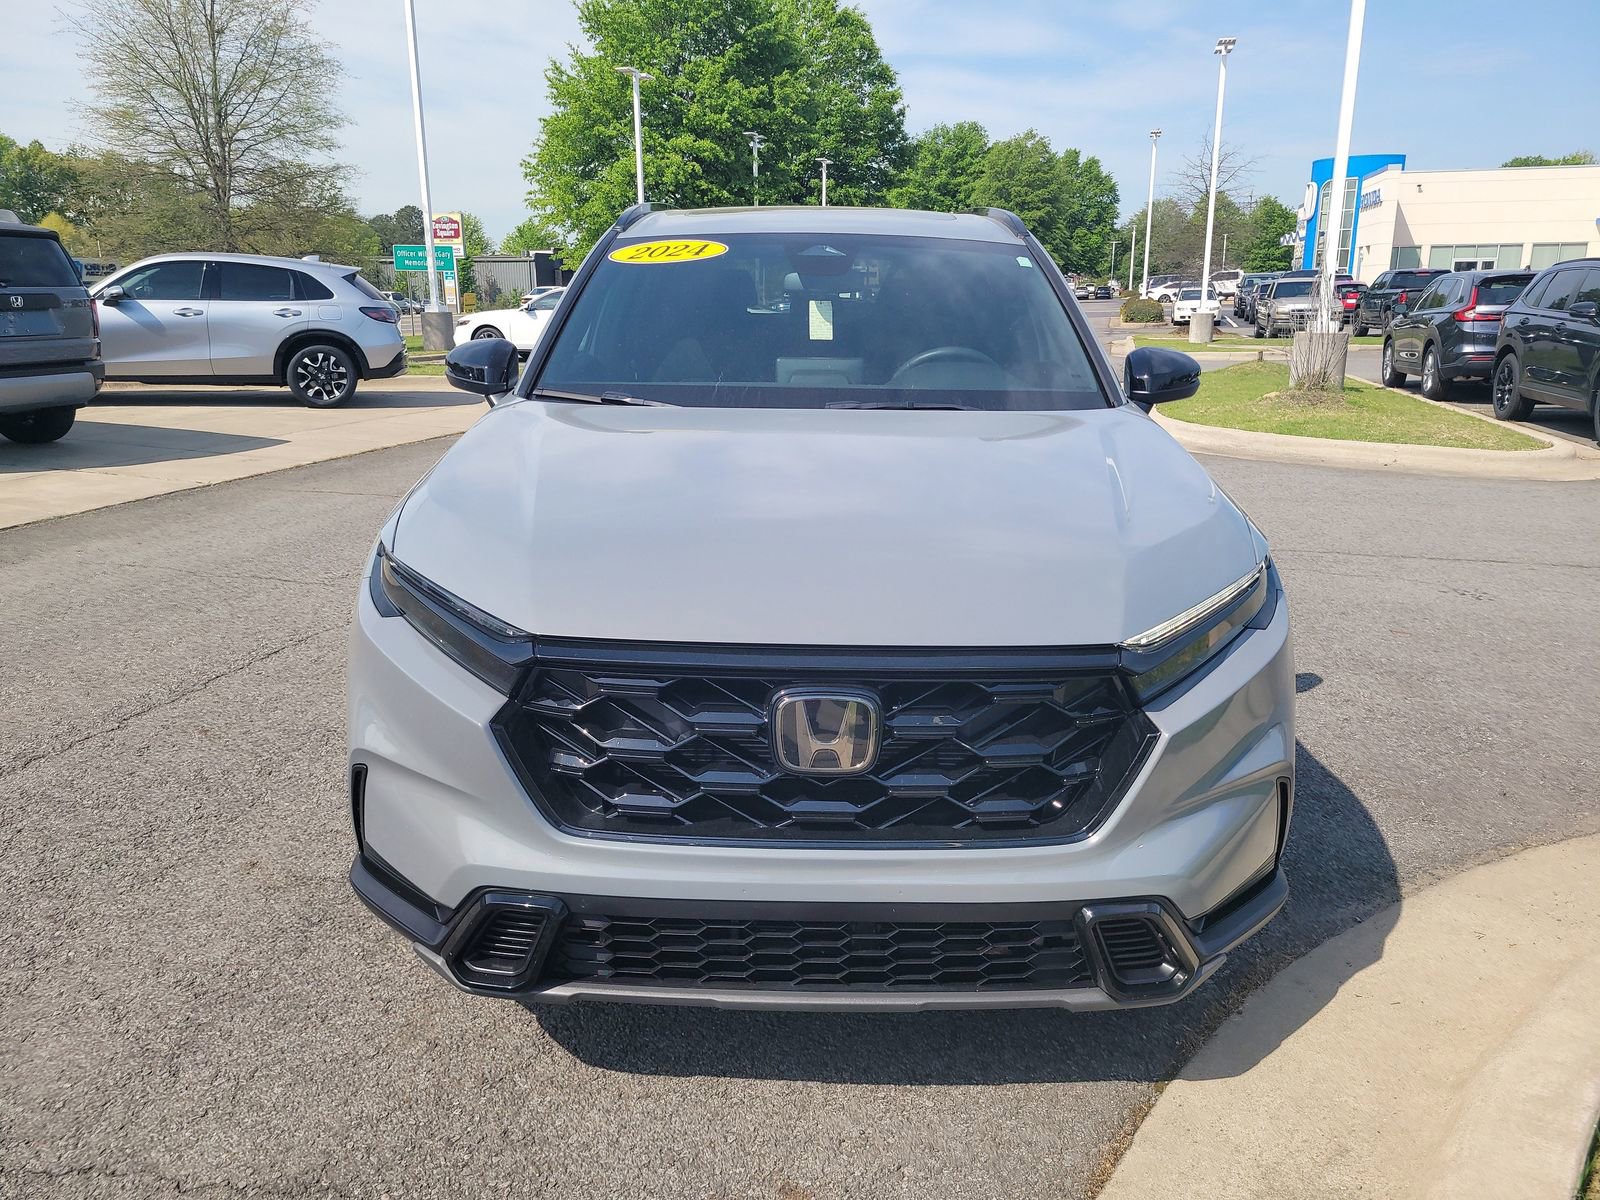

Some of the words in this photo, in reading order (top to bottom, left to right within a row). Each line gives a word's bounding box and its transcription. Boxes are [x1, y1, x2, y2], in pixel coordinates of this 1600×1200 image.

[436, 229, 454, 237] Square
[435, 251, 450, 259] cGary
[627, 243, 711, 260] 2024
